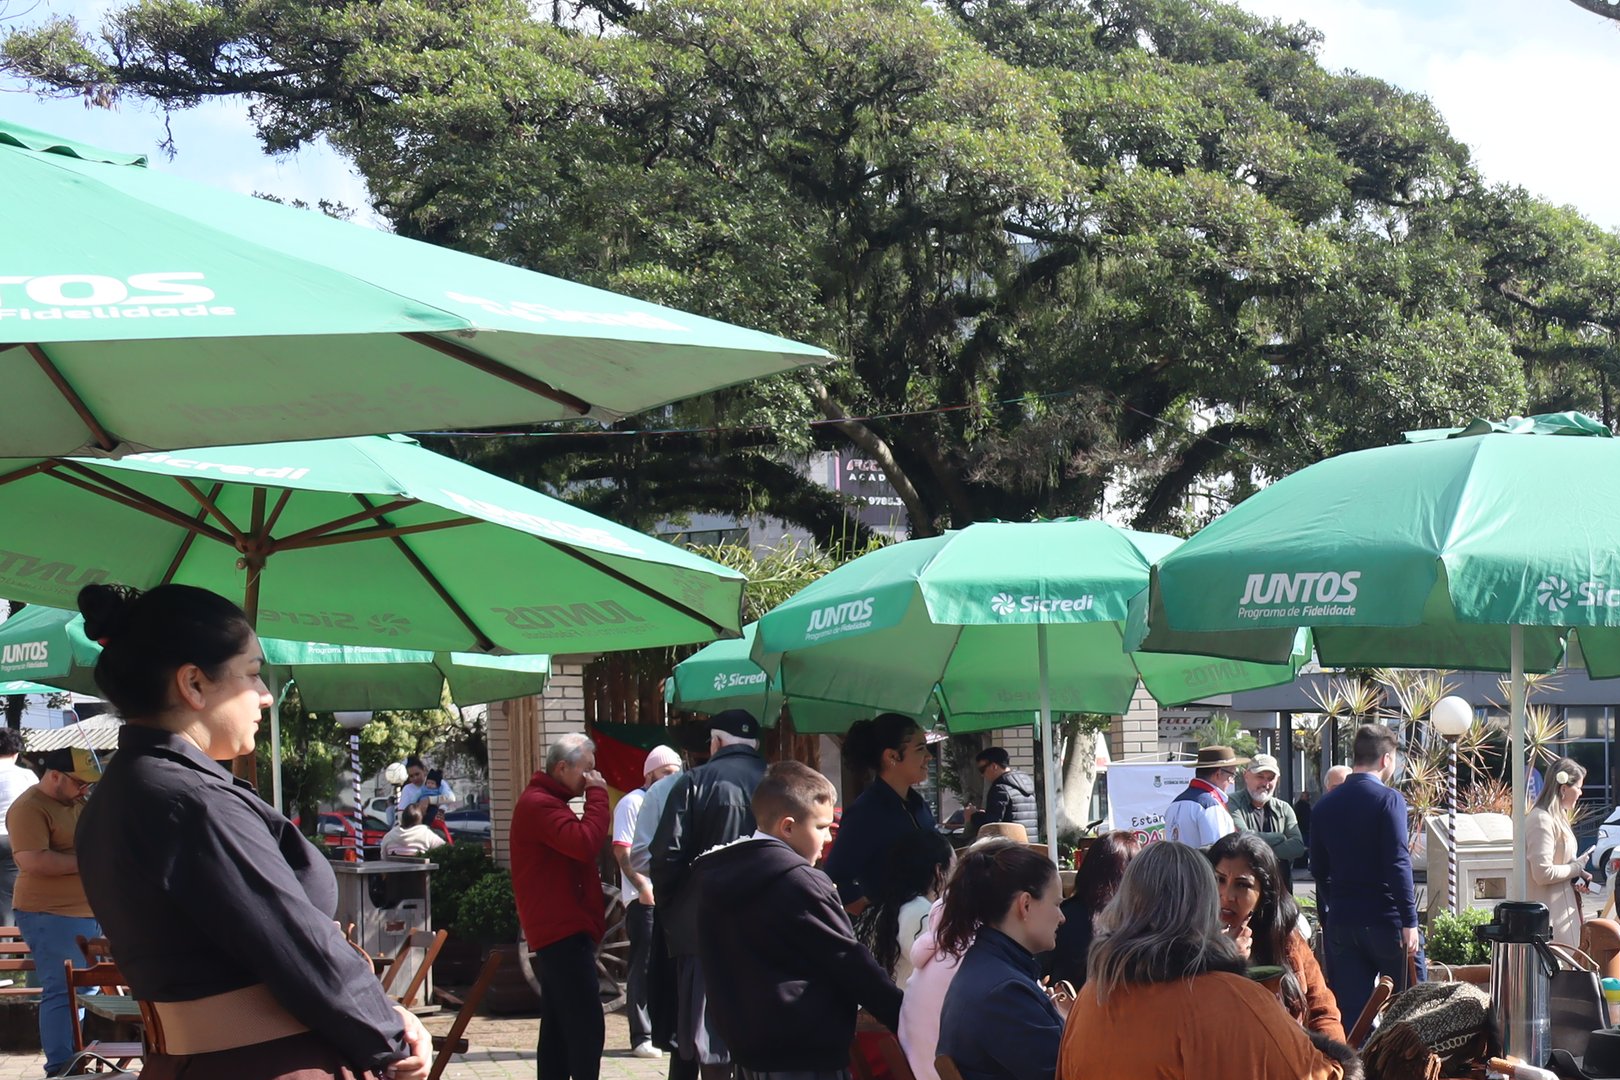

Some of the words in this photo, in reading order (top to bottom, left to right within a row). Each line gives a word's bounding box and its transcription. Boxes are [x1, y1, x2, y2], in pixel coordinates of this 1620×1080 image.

[1239, 571, 1362, 605] JUNTOS
[806, 597, 875, 632] JUNTOS
[1019, 594, 1094, 613] Sicredi
[1238, 606, 1286, 620] Programa
[1287, 606, 1301, 617] de
[1302, 604, 1357, 617] Fidelidade
[1, 640, 49, 664] JUNTOS
